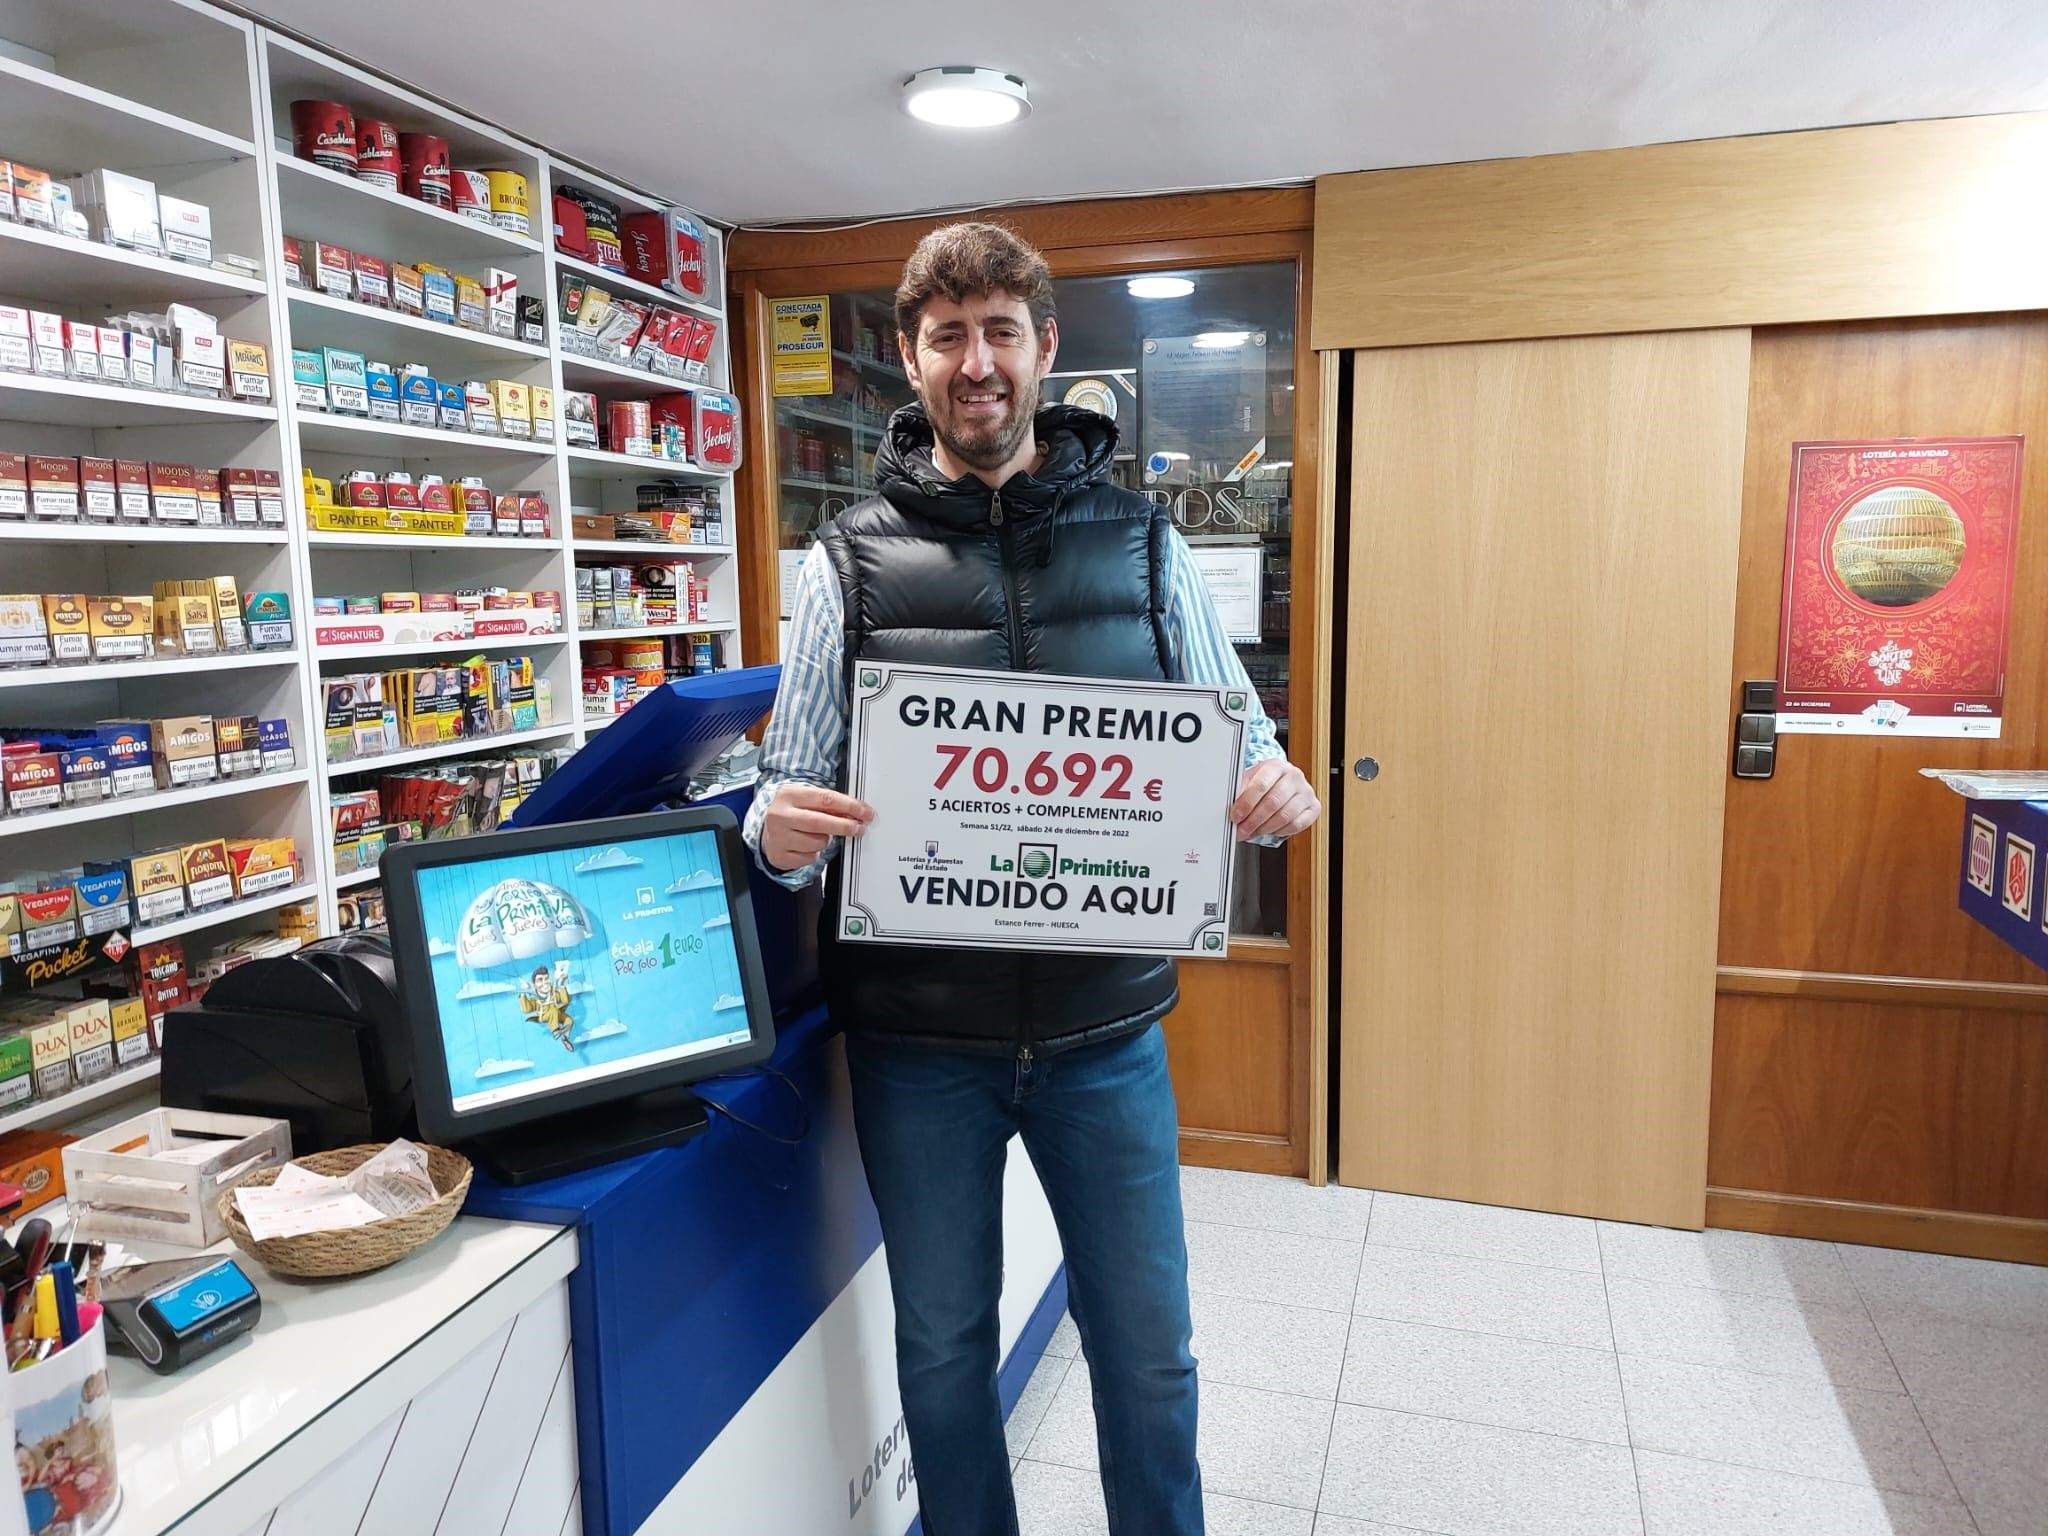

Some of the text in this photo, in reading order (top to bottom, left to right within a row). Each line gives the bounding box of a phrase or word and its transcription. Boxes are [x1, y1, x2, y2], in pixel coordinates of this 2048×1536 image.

[630, 231, 650, 273] Jockey
[776, 303, 822, 312] CONECTADA
[777, 341, 824, 351] PROSEGUR
[184, 365, 205, 375] Fumar
[240, 375, 264, 385] Fumar
[243, 383, 264, 392] mata
[298, 385, 319, 394] Fumar
[336, 386, 363, 398] Fumar
[301, 394, 317, 402] mata
[340, 398, 362, 407] mata
[410, 404, 430, 413] Fumar
[445, 408, 461, 417] Fumar
[412, 412, 428, 420] mata
[703, 425, 732, 451] Jockey
[1908, 449, 1949, 457] NAVIDAD
[40, 463, 69, 472] MOODS
[86, 462, 113, 470] MOODS
[120, 464, 146, 472] MOODS
[157, 466, 190, 476] MOODS
[329, 513, 456, 531] PANTER PANTER
[55, 612, 83, 620] PONCHO
[103, 614, 132, 622] PONCHO
[187, 609, 208, 619] Salsa
[648, 610, 669, 618] West
[259, 625, 283, 634] Fumar
[487, 623, 525, 633] SIGNATURE
[263, 632, 282, 640] mata
[332, 629, 380, 641] SIGNATURE
[693, 635, 707, 643] 280
[0, 643, 47, 653] umar mata
[97, 638, 143, 648] Fumar mata
[64, 645, 82, 653] mata
[585, 705, 606, 713] mata
[899, 695, 1202, 743] GRAN PREMIO
[170, 732, 211, 748] AMIGOS
[221, 757, 242, 765] Fumar
[66, 760, 106, 774] AMIGOS
[172, 761, 215, 773] Fumar mata
[933, 744, 1163, 801] 70.692 €
[12, 768, 55, 783] AMIGOS
[132, 771, 151, 780] mata
[13, 787, 59, 799] Fumar mata
[929, 799, 937, 810] 5
[940, 799, 1011, 815] ACIERTOS
[1026, 804, 1163, 823] COMPLEMENTARIO
[960, 821, 989, 831] Semana
[1016, 824, 1043, 834] sábado
[1054, 826, 1064, 834] de
[1065, 826, 1100, 836] diciembre
[1101, 828, 1111, 836] de
[1112, 829, 1130, 837] 2022
[933, 857, 964, 866] Apuestas
[990, 854, 1151, 879] La Primitiva
[190, 861, 226, 880] FLORIDITA
[925, 863, 949, 872] Estado
[141, 874, 177, 892] FLORIDITA
[244, 870, 290, 887] Fumar mata
[80, 878, 122, 893] VEGAFINA
[193, 883, 230, 897] Fumar mata
[900, 875, 1178, 916] VENDIDO AQUÍ
[25, 895, 70, 910] VEGAFINA
[141, 895, 182, 910] Fumar mata
[635, 905, 674, 918] PRIMITIVA
[994, 919, 1080, 929] Estanco Ferrer HUESCA
[28, 928, 53, 940] Fumar
[13, 946, 62, 964] VEGAFINA
[658, 932, 676, 968] 1
[26, 938, 90, 988] Pocket
[150, 962, 178, 980] TOSCANO
[73, 1016, 108, 1040] DUX
[35, 1035, 67, 1056] DUX
[79, 1047, 110, 1063] Fumar
[83, 1057, 107, 1070] mata
